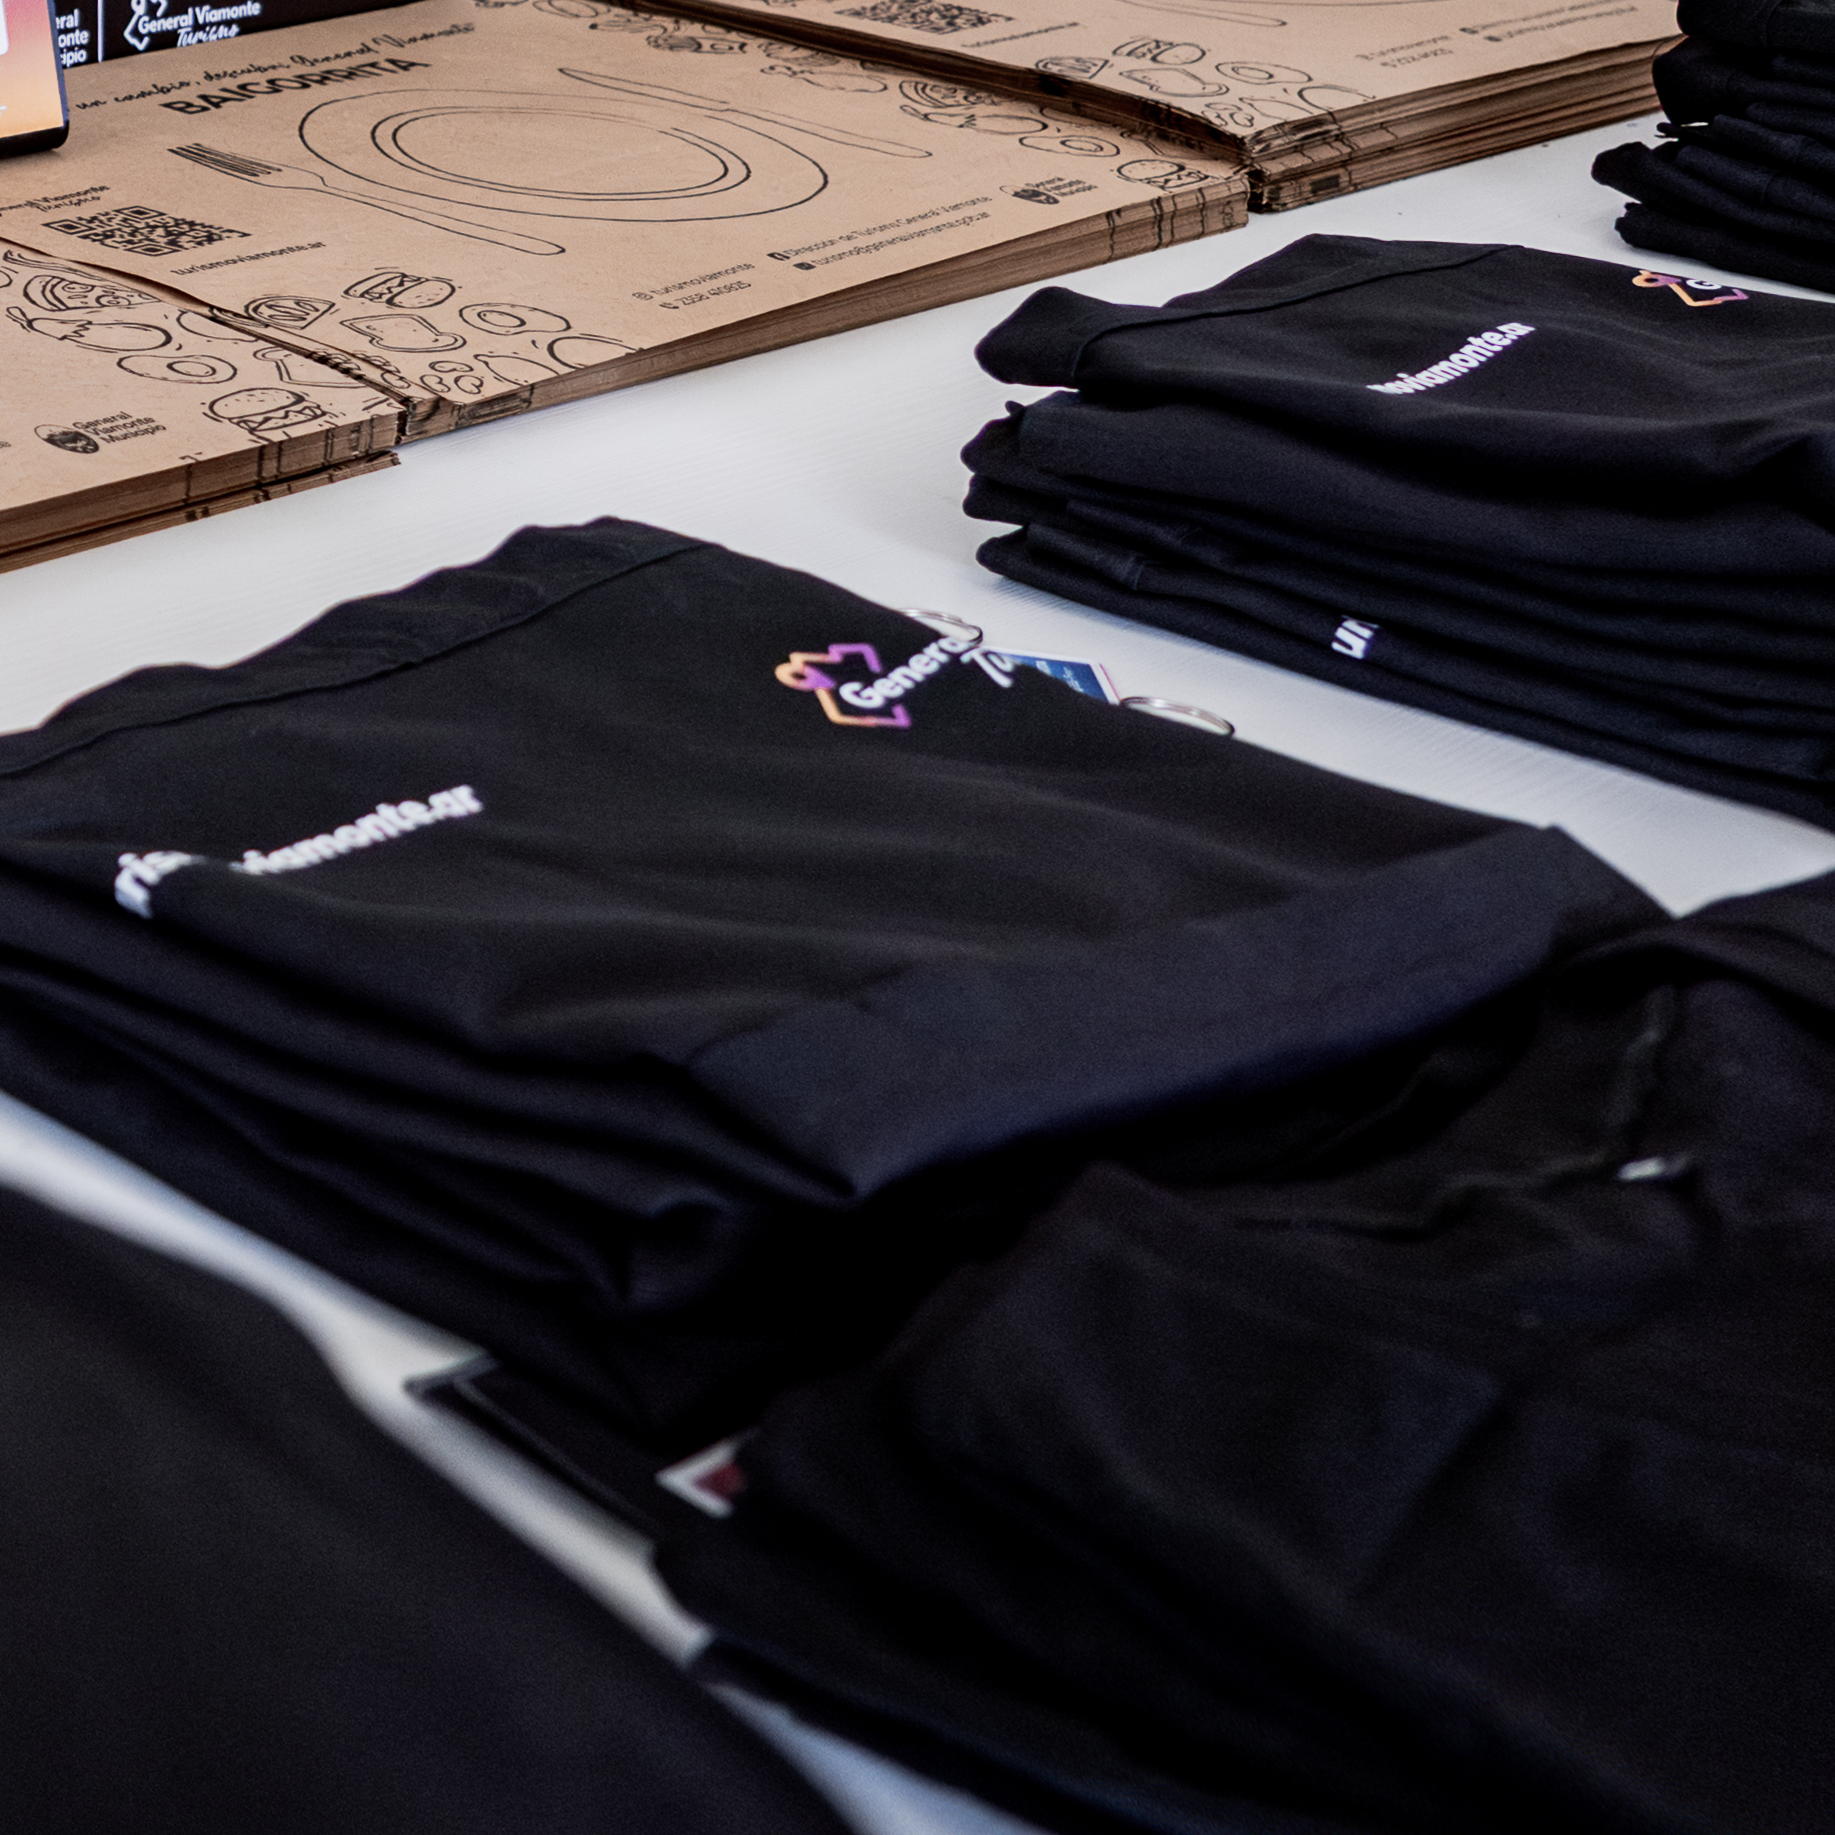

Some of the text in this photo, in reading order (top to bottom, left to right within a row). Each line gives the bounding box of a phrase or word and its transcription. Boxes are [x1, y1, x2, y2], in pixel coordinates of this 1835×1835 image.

[137, 0, 262, 34] General Viamonte
[158, 58, 432, 114] BAIGORRITA
